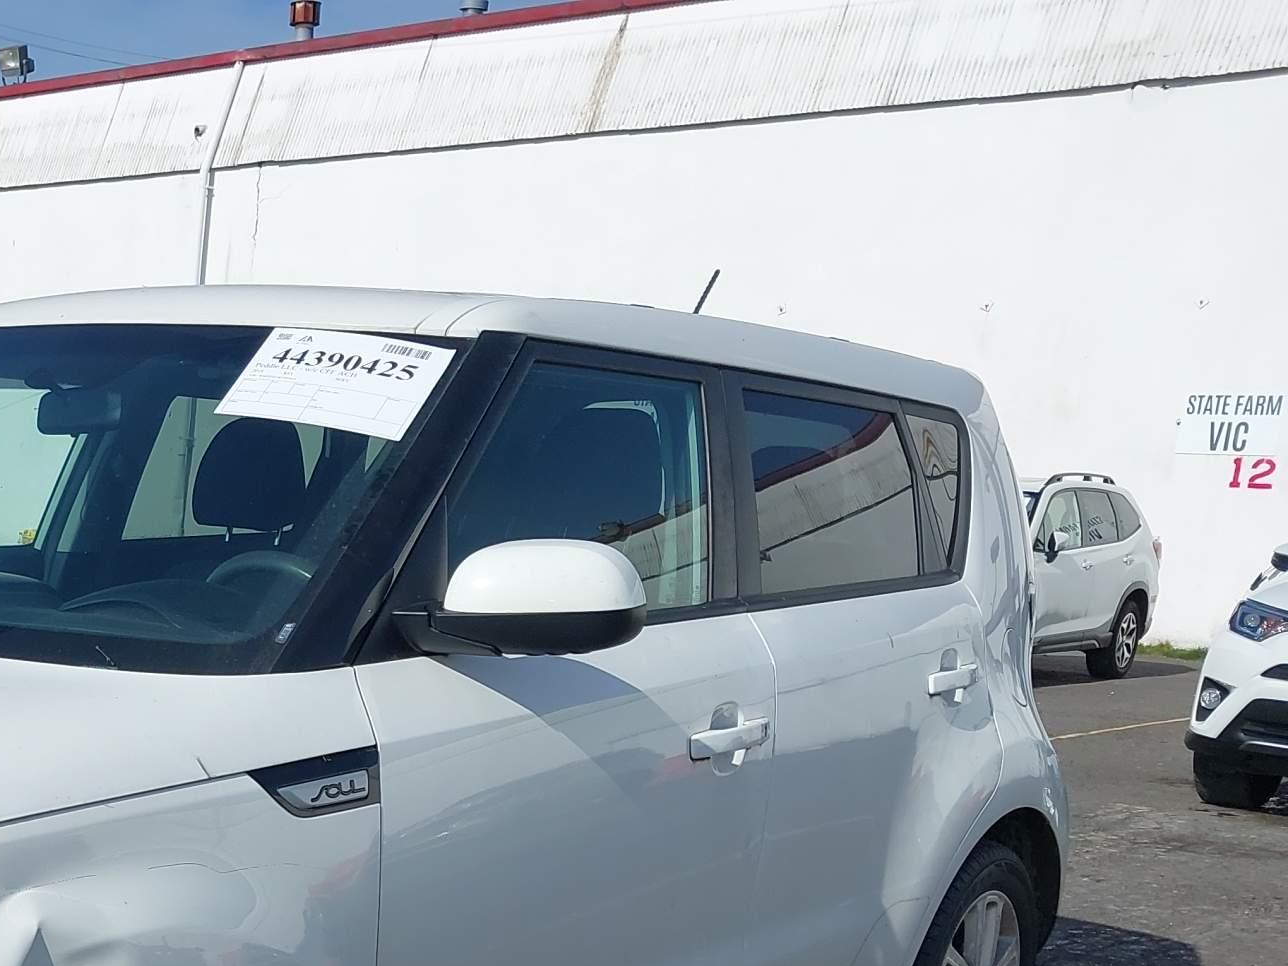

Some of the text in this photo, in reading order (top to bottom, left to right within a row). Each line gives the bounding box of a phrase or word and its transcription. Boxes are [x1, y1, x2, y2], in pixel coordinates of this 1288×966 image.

[272, 348, 419, 381] 44390425
[1186, 394, 1283, 416] STATE FARM
[1209, 421, 1249, 452] VIC
[1229, 457, 1276, 489] 12
[310, 779, 366, 802] SOUL
